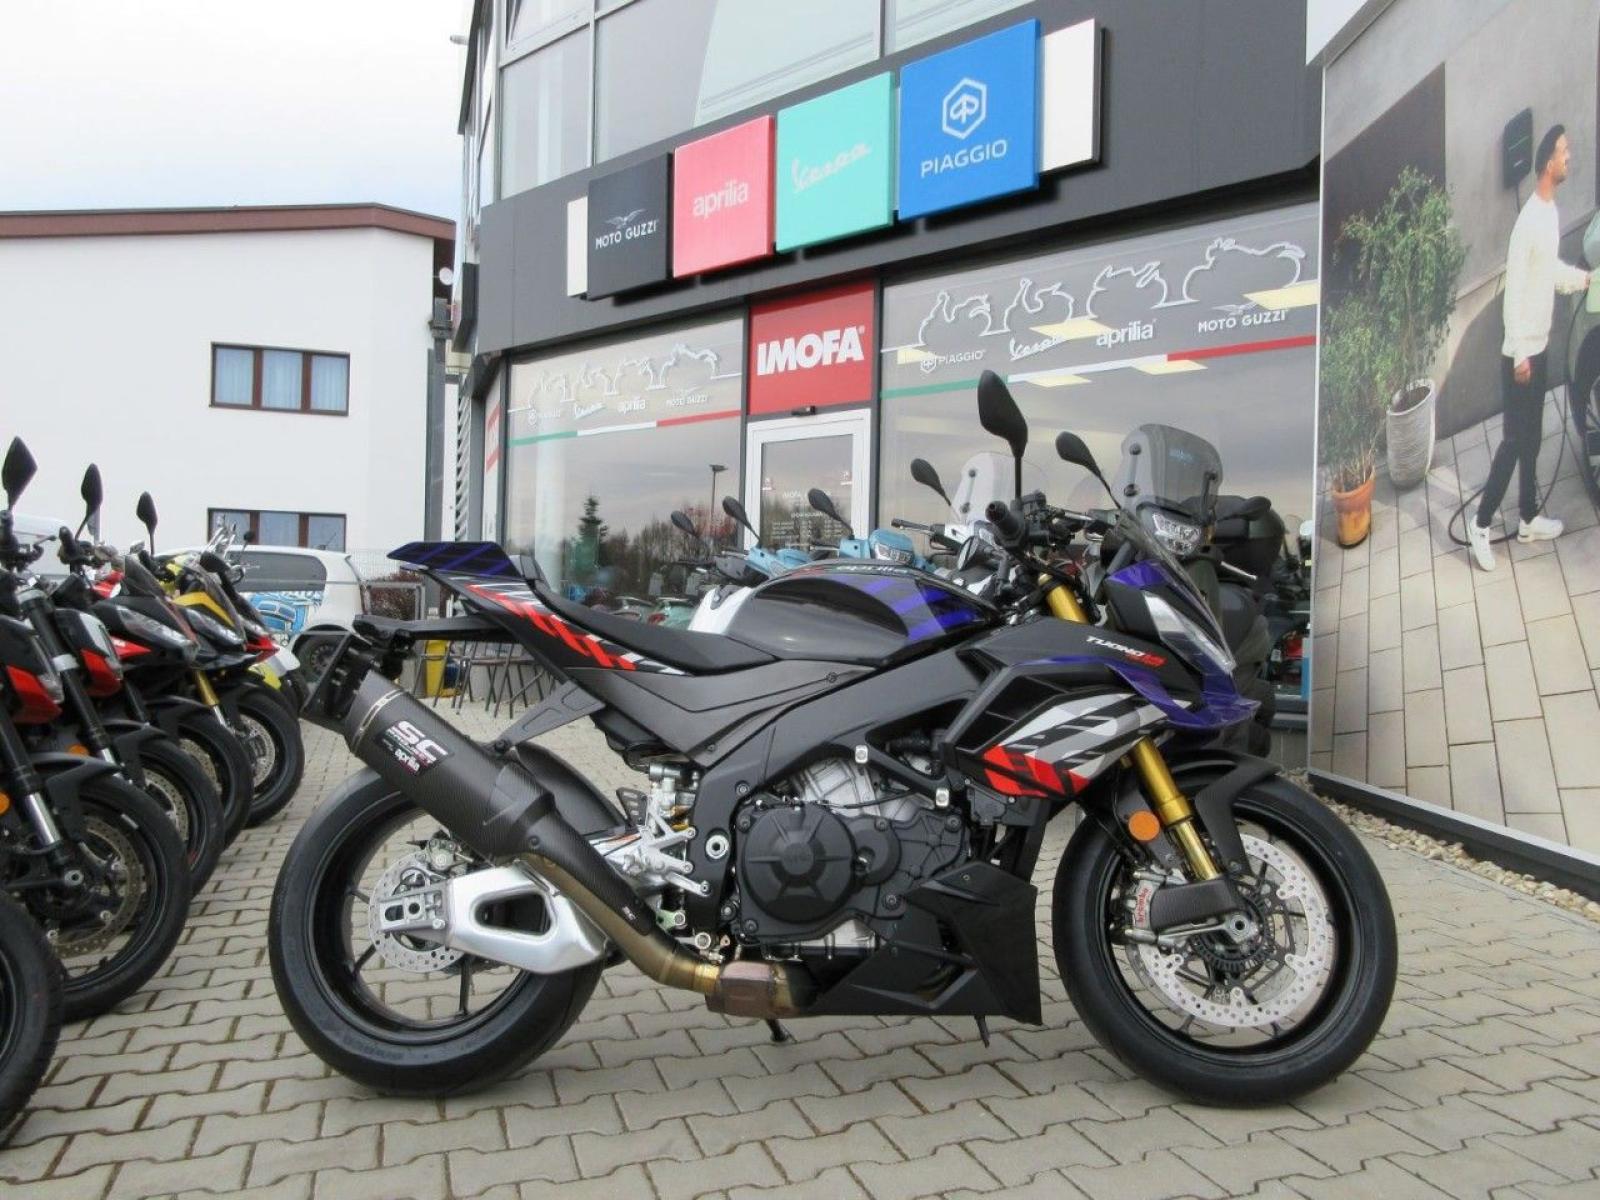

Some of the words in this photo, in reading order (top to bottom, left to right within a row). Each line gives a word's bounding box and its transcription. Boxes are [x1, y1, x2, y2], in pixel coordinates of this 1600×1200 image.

[791, 142, 872, 193] Vespa
[920, 139, 1008, 178] PIAGGIO
[692, 179, 748, 219] aprilia
[595, 230, 622, 249] MOTO
[625, 219, 657, 240] GUZZI
[1096, 320, 1154, 348] aprilia
[1198, 317, 1237, 333] MOTO
[1241, 309, 1286, 326] GUZZI
[757, 326, 864, 376] IMOFA
[938, 350, 984, 365] PIAGGIO
